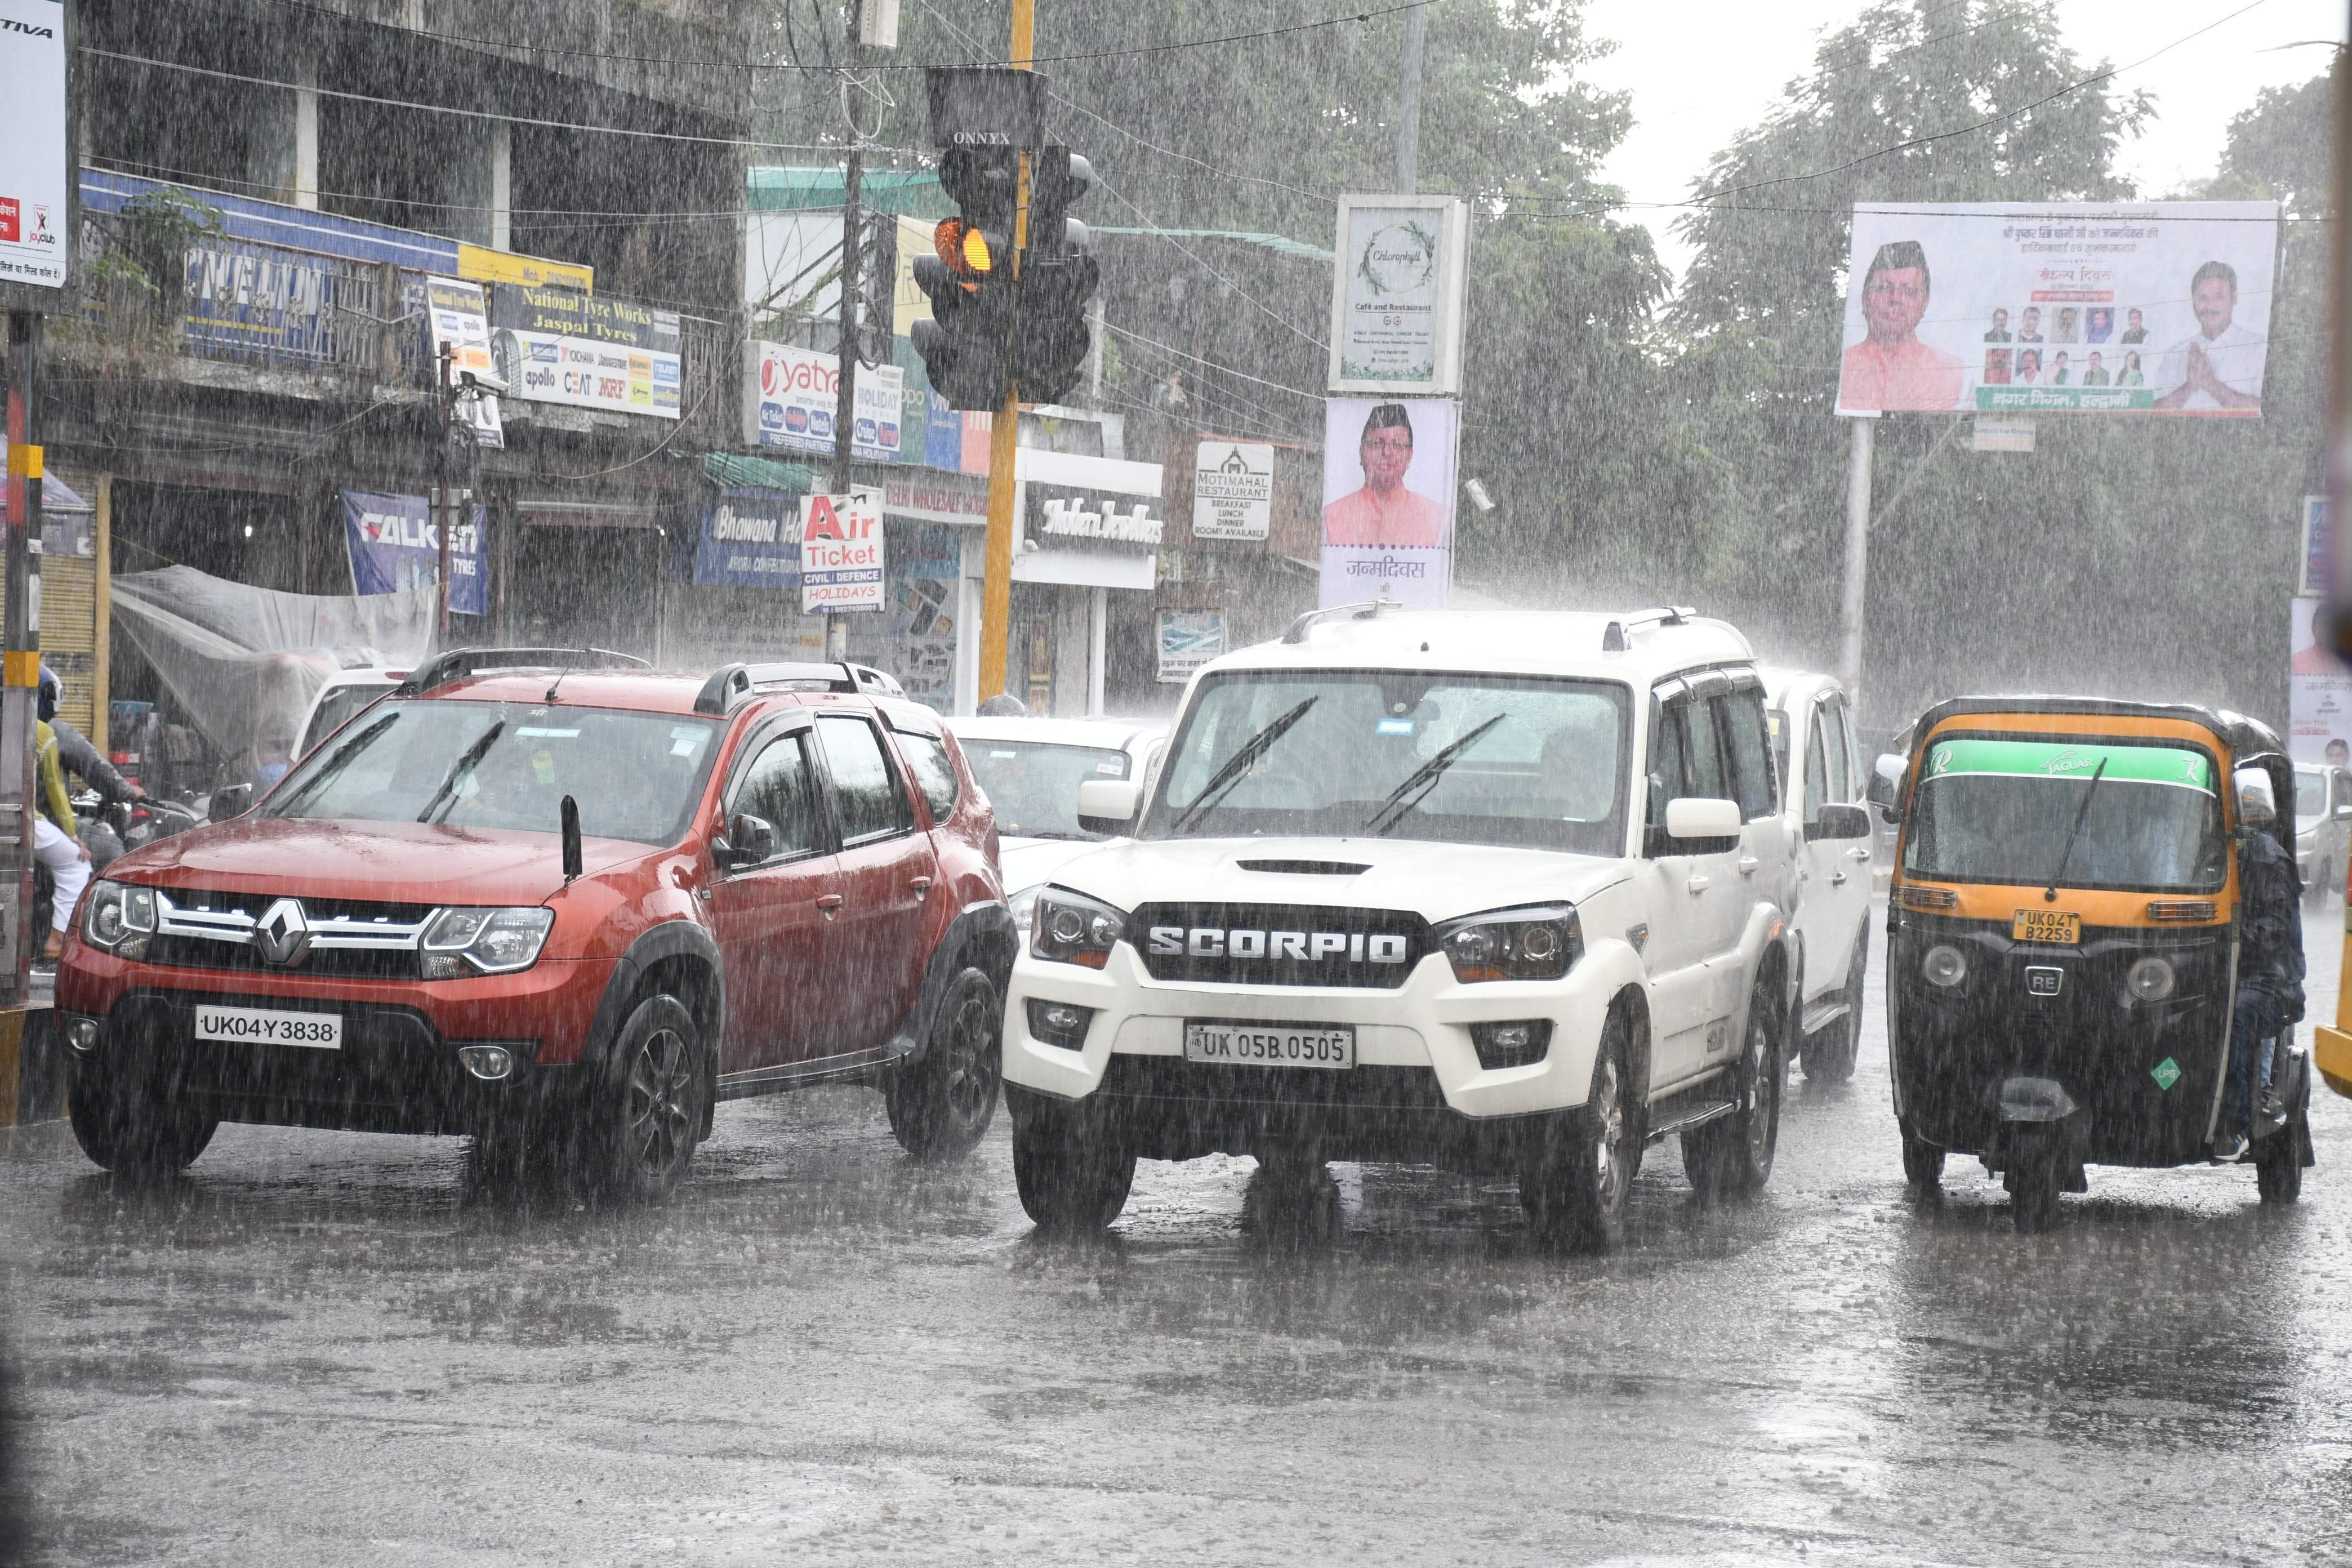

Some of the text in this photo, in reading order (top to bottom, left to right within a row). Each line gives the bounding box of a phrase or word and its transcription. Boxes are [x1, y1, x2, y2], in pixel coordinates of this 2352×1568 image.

[0, 19, 52, 39] TIVA
[954, 131, 1010, 145] ONNYX
[29, 230, 55, 244] joyclub
[1373, 250, 1422, 265] Chlorophyll
[522, 287, 579, 312] National
[582, 297, 610, 319] Tyre
[612, 302, 652, 326] Works
[533, 314, 589, 334] Jaspal
[593, 323, 638, 342] Tyres
[525, 367, 555, 391] apollo
[564, 371, 592, 396] CEAT
[599, 377, 626, 400] MRF
[858, 387, 898, 411] HOLIDAY
[769, 433, 832, 453] PREFERRED PARTNER
[1198, 473, 1268, 488] MOTIMAHAL
[1198, 485, 1268, 497] RESTAURANT
[1212, 500, 1252, 509] BREAKFAST
[1218, 509, 1244, 518] LUNCH
[718, 505, 777, 543] Bhawana
[804, 496, 875, 541] Air
[1217, 518, 1244, 527] DINNER
[1195, 527, 1264, 537] ROOMS AVAILABLE
[807, 544, 875, 567] Ticket
[452, 557, 476, 577] TYRES
[1347, 555, 1426, 578] जन्मदिवस
[804, 573, 829, 583] CIVIL
[836, 571, 879, 582] DEFENCE
[809, 586, 876, 600] HOLIDAYS
[2049, 759, 2093, 775] JAGUAR
[2028, 912, 2074, 928] UK04T
[2026, 926, 2073, 941] B2259
[1150, 926, 1407, 964] SCORPIO
[2033, 976, 2056, 990] RE
[204, 1015, 333, 1042] UK04Y3838
